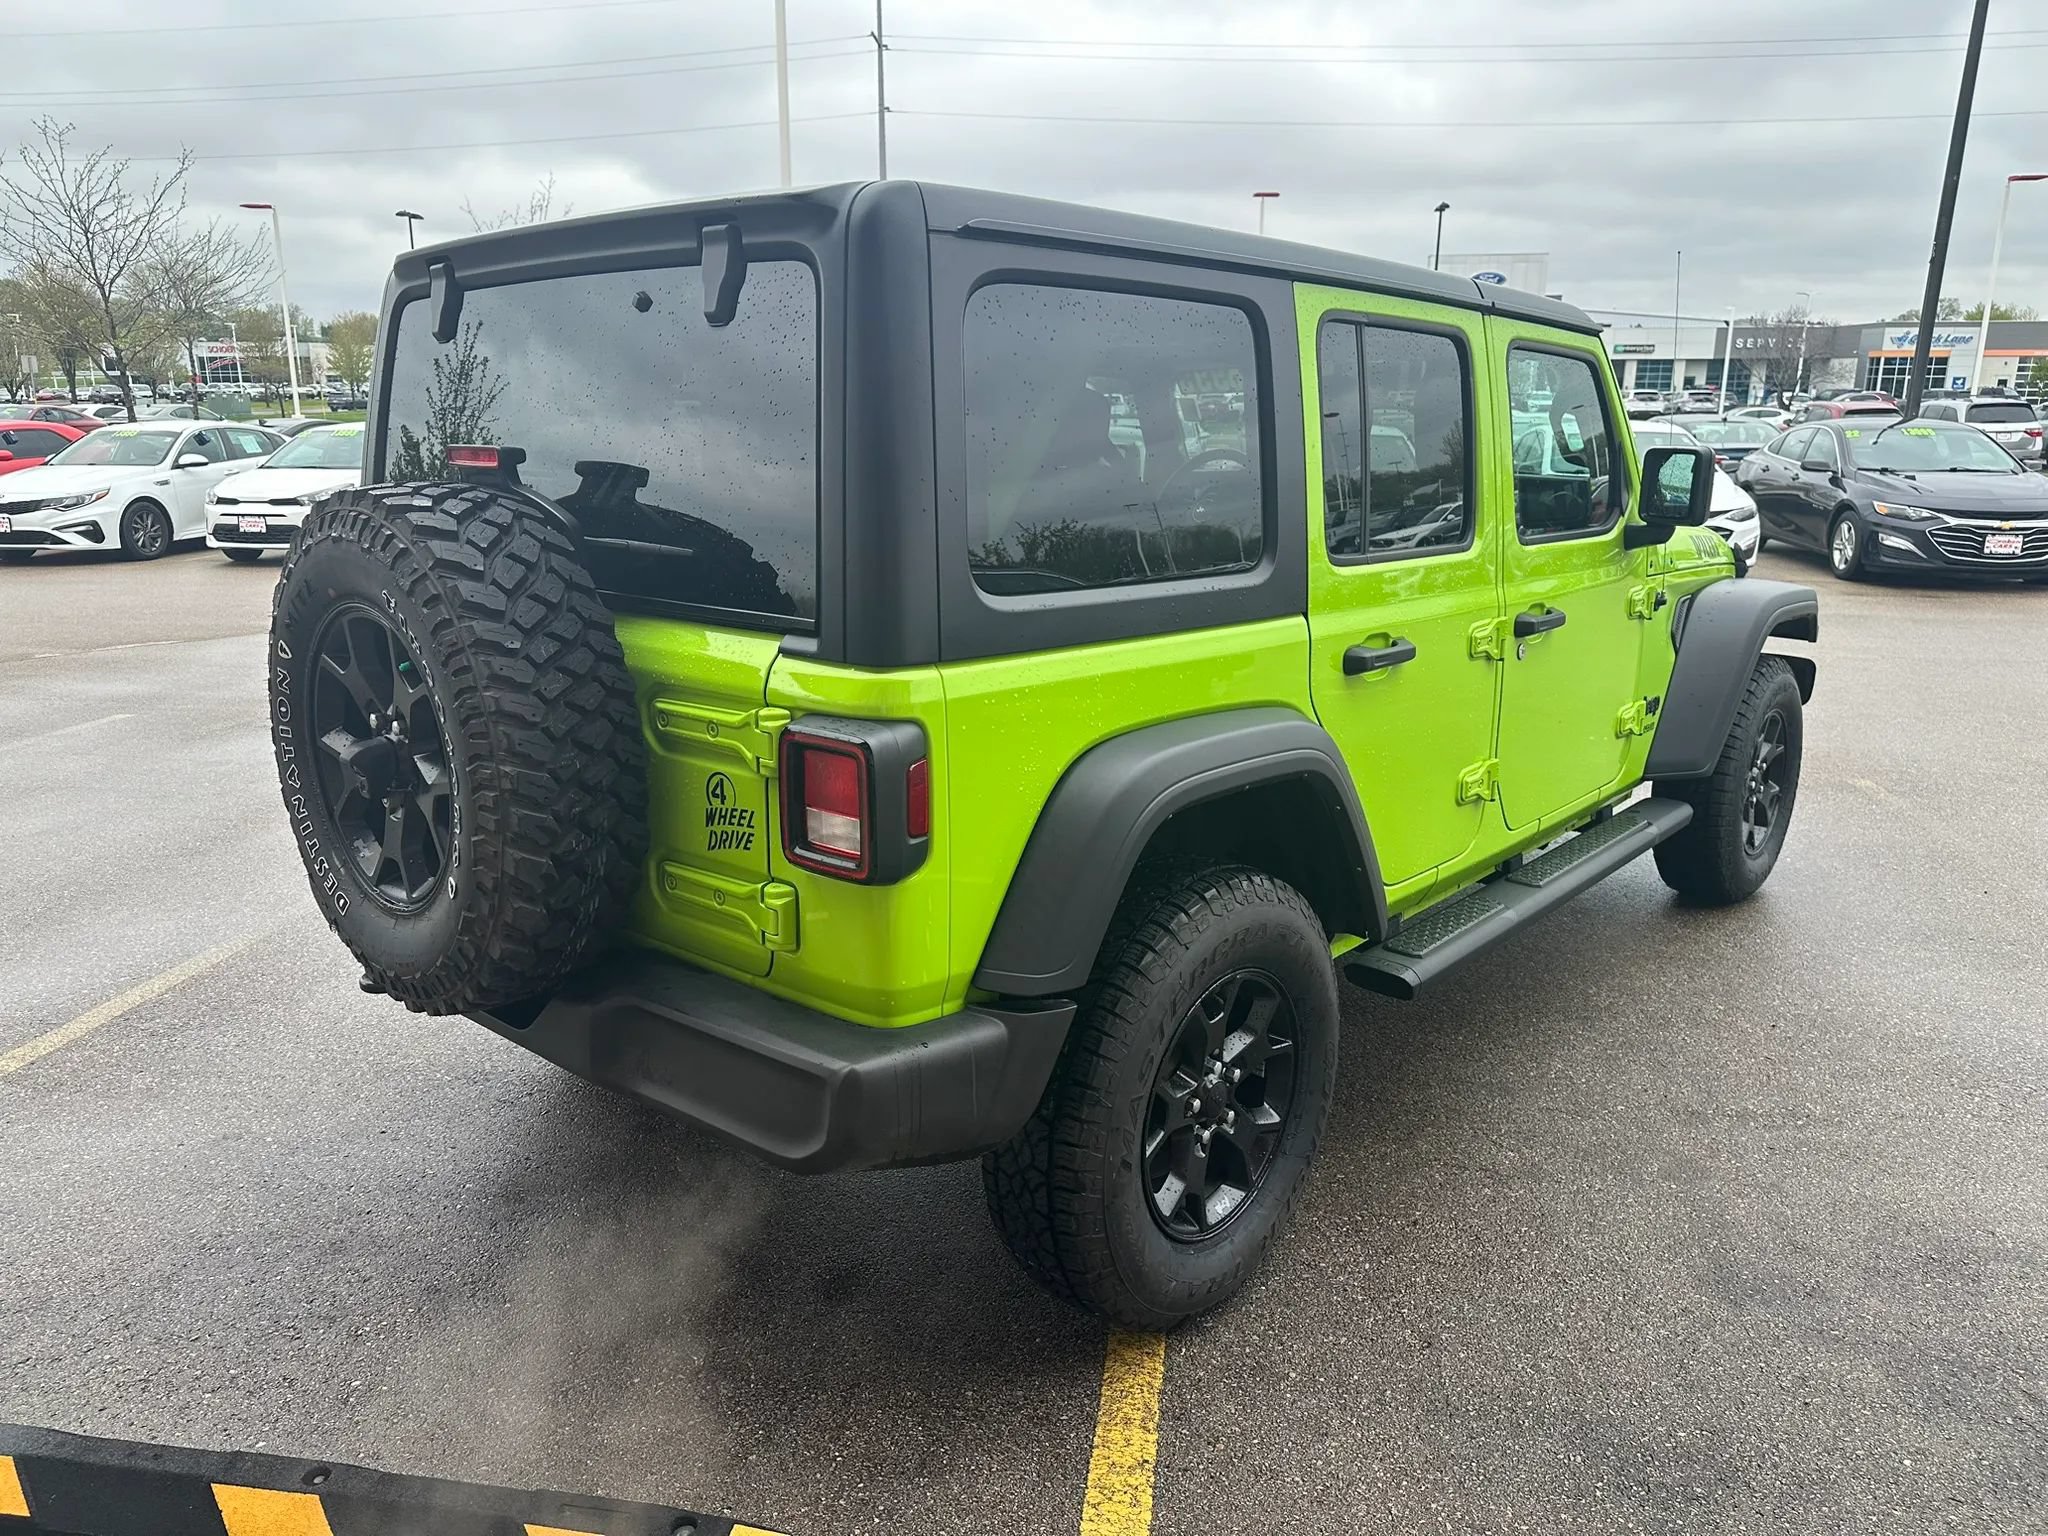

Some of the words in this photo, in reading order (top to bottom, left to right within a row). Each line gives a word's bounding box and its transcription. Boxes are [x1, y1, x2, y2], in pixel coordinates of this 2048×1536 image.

[1942, 334, 1974, 345] Lane
[276, 667, 350, 916] DESTINATION
[705, 807, 755, 829] WHEEL
[707, 829, 755, 851] DRIVE
